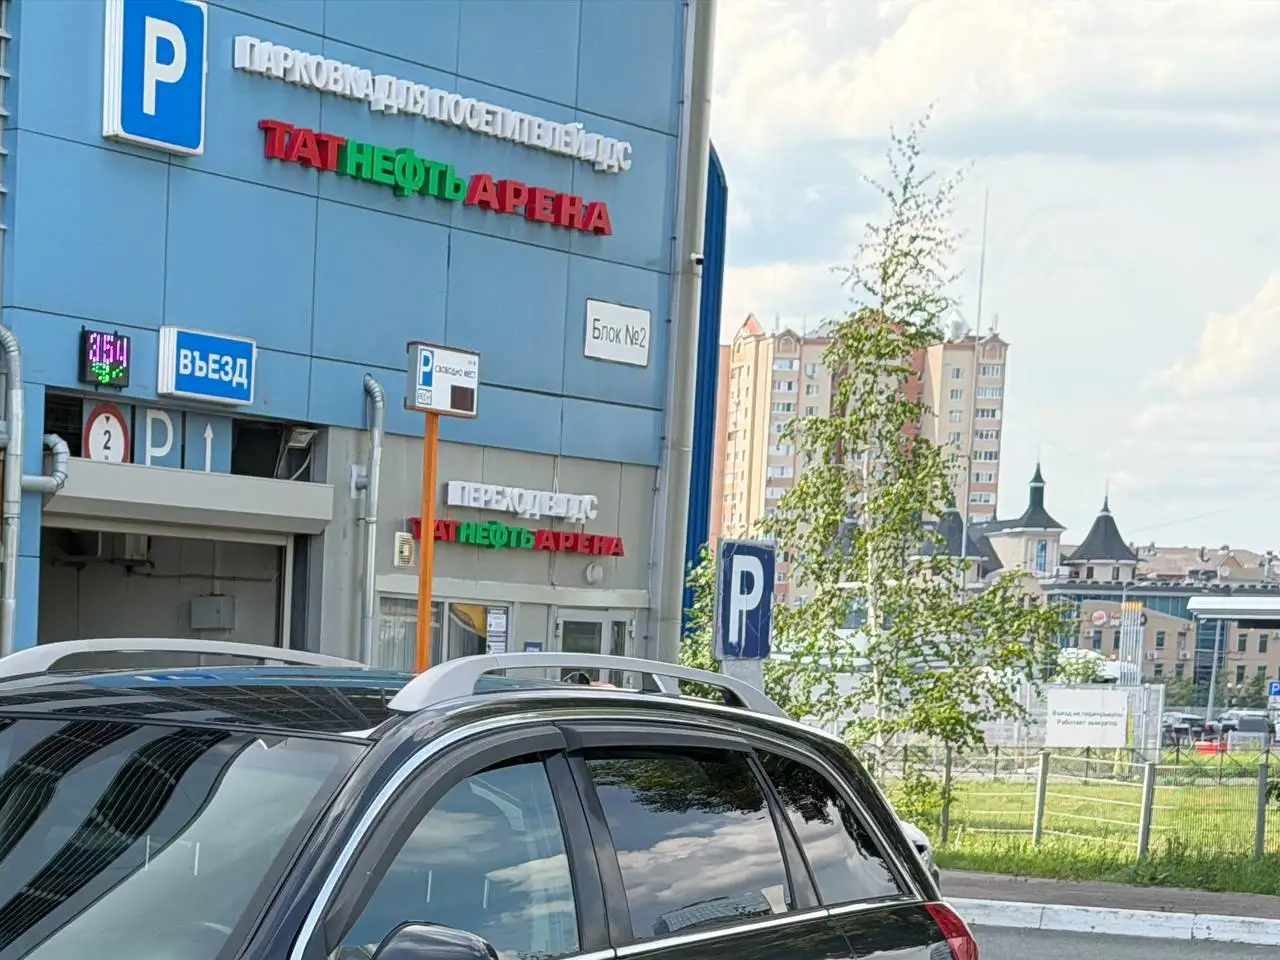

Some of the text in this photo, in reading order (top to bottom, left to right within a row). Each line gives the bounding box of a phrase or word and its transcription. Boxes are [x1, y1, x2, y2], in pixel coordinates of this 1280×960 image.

[143, 15, 187, 116] P
[234, 35, 373, 101] ПАРКОВКА
[370, 74, 431, 114] ДЛЯ
[428, 88, 587, 159] ПОСЕТИТЕЛЕЙ
[592, 317, 647, 348] Блок №2
[178, 348, 248, 389] ВЪЕЗД
[419, 350, 433, 386] P
[103, 429, 112, 450] 2
[145, 409, 174, 466] P
[448, 480, 541, 520] ПЕРЕХОД
[728, 554, 765, 645] P
